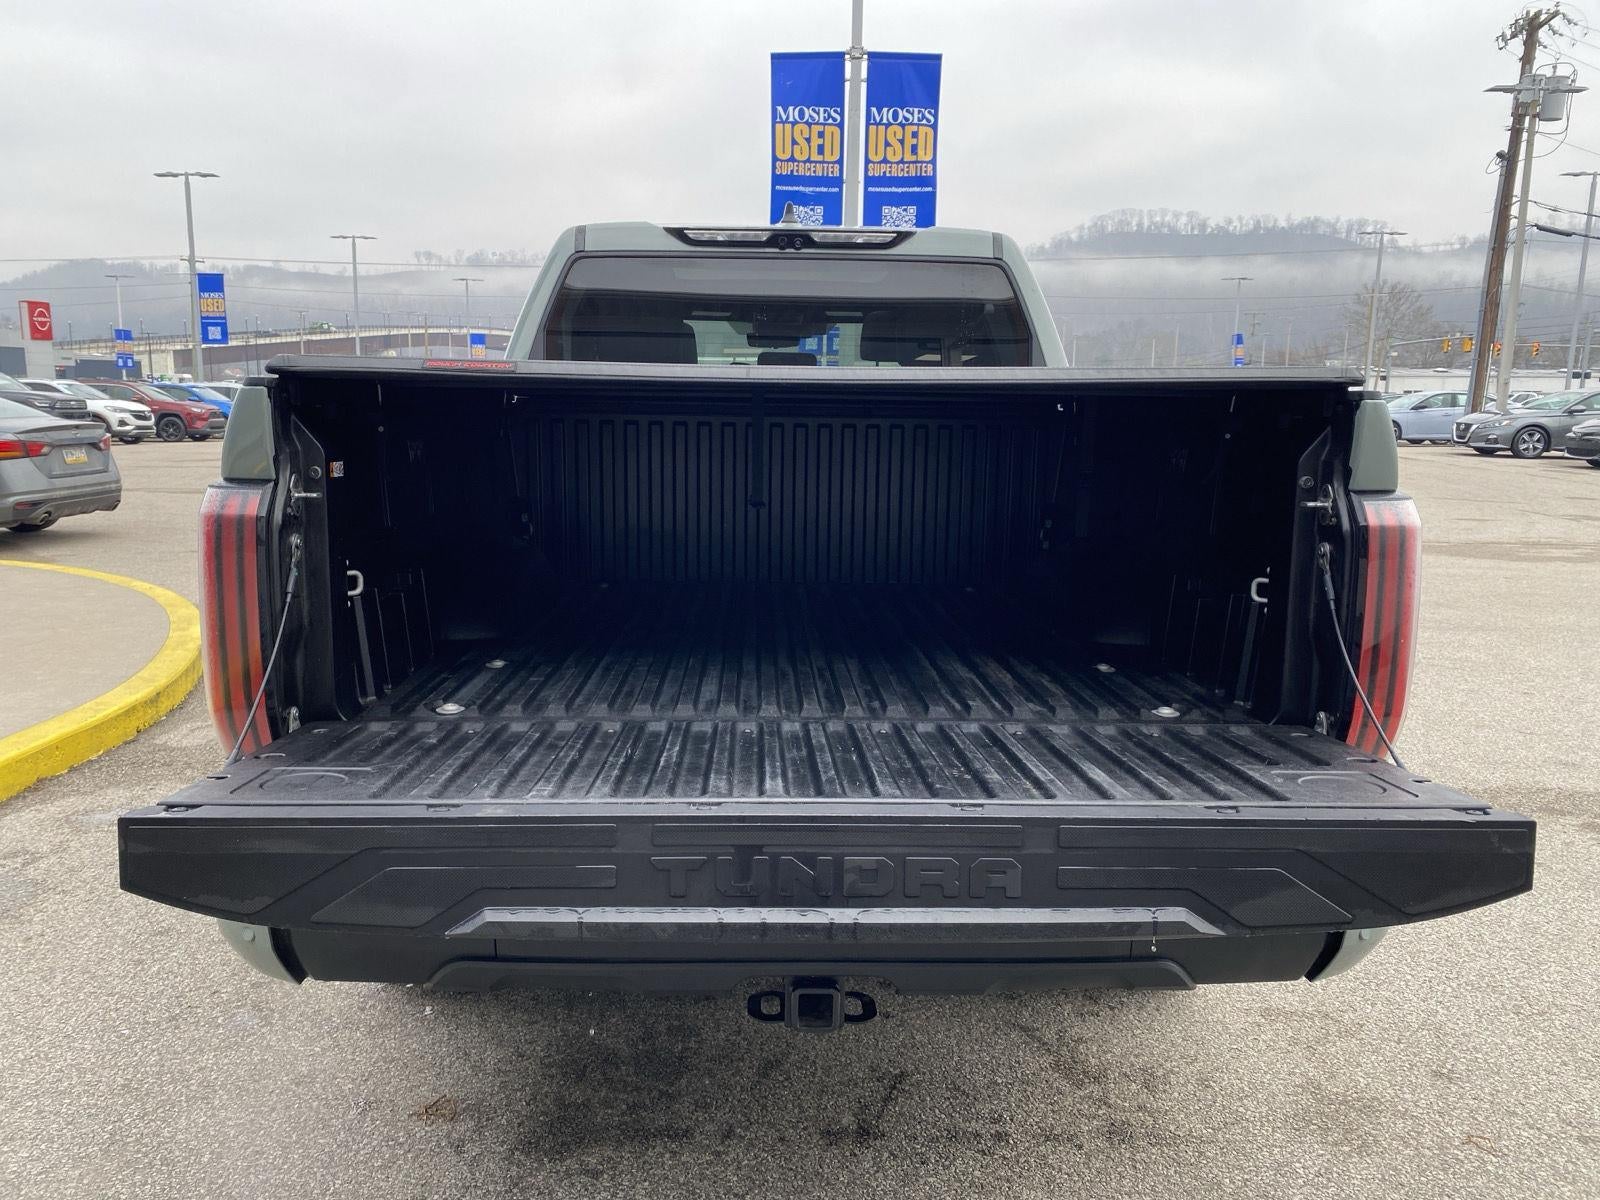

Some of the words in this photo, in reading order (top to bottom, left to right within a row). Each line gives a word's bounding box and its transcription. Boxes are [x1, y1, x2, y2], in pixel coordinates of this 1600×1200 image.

[775, 105, 841, 124] MOSES
[870, 106, 935, 124] MOSES
[775, 123, 841, 162] USED
[868, 124, 934, 162] USED
[775, 162, 840, 177] SUPERCENTER
[867, 163, 934, 177] SUPERCENTER
[200, 291, 224, 299] MOSES
[200, 298, 225, 312] USED
[650, 856, 1022, 898] TUNDRA
